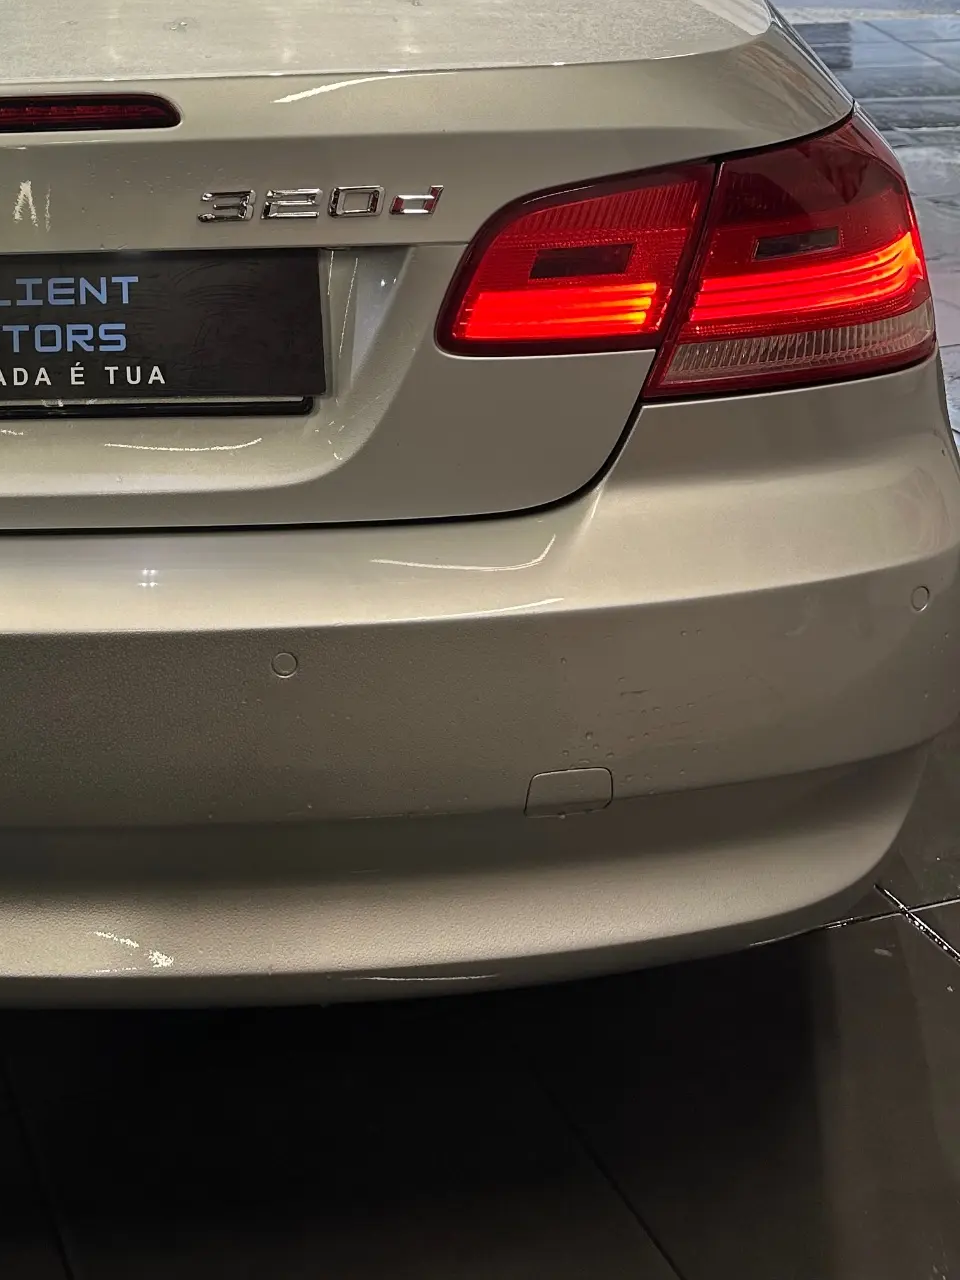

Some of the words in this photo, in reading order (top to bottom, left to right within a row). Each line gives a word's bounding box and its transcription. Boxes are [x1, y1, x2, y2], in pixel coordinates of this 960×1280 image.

[197, 185, 444, 222] 320d
[70, 362, 85, 385] É
[104, 365, 166, 385] TUA
